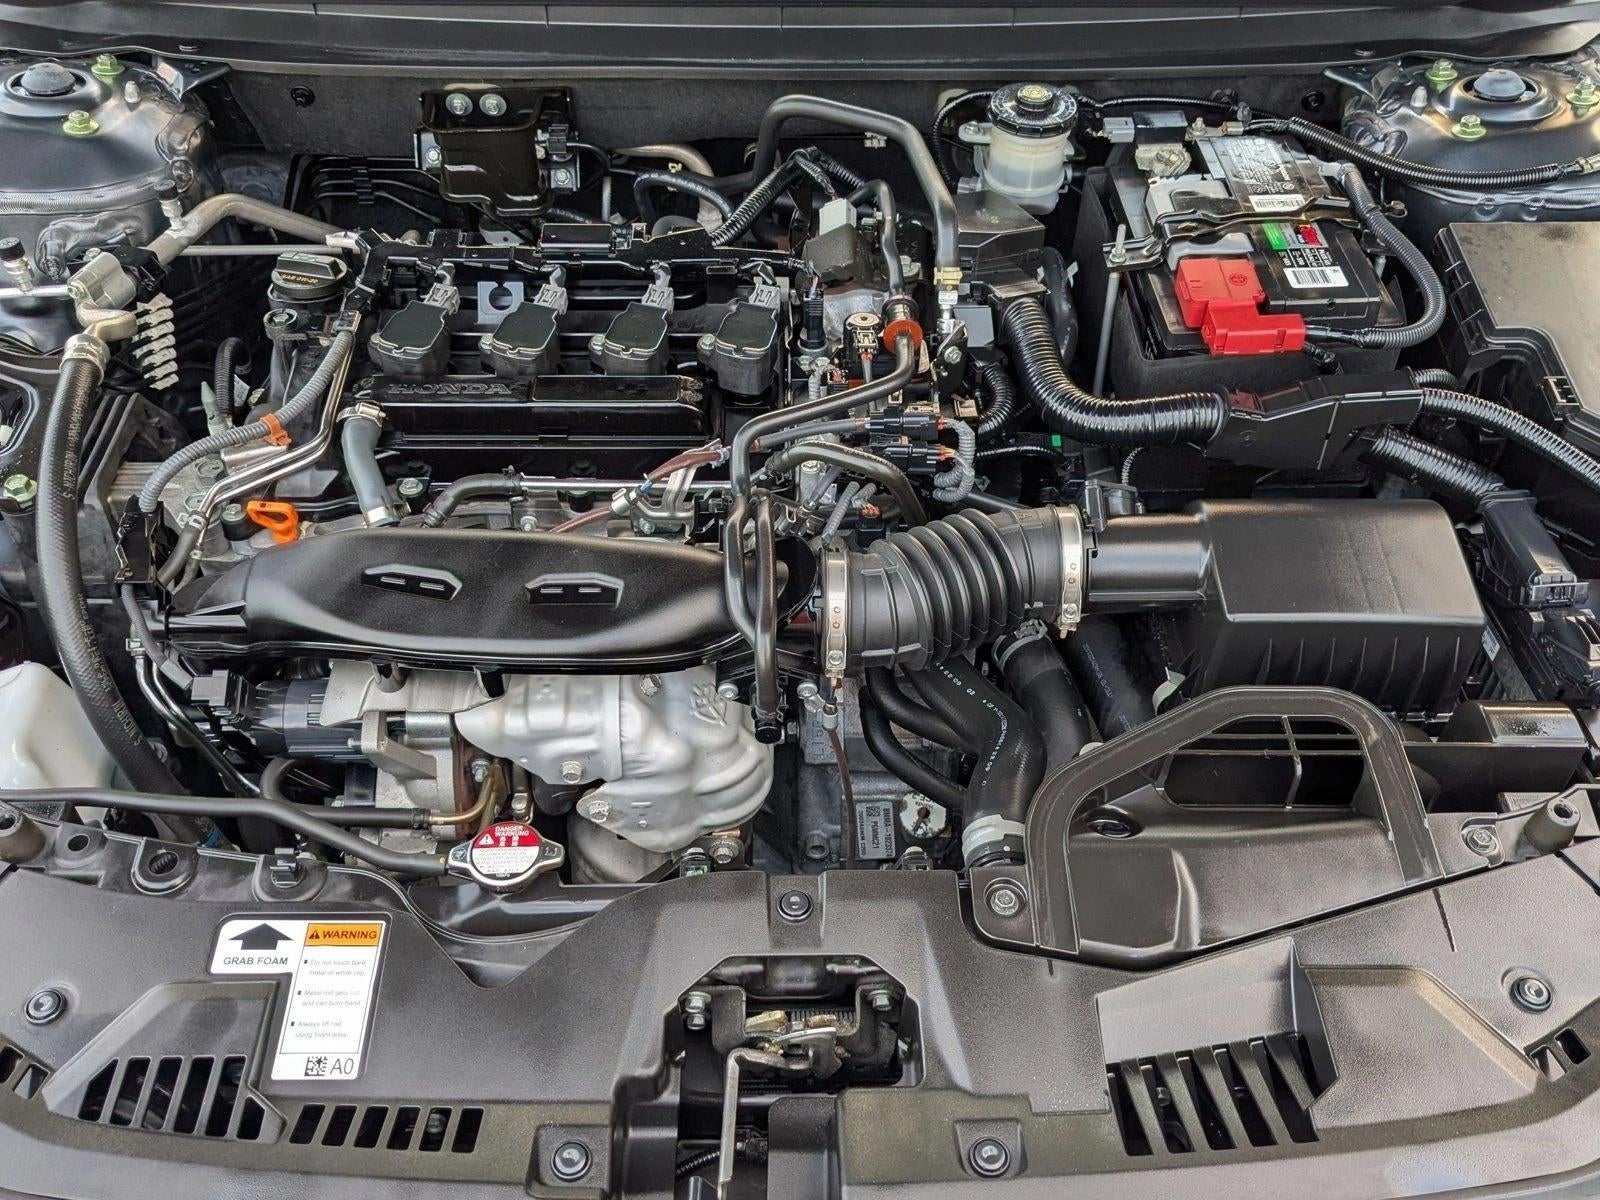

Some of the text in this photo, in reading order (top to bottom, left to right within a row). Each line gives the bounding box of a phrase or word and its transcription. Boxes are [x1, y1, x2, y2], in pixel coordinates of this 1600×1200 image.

[387, 383, 512, 395] HONDA
[323, 930, 377, 939] WARNING
[223, 957, 289, 965] GRAB FOAM
[297, 1020, 320, 1028] Always
[330, 1058, 354, 1075] A0
